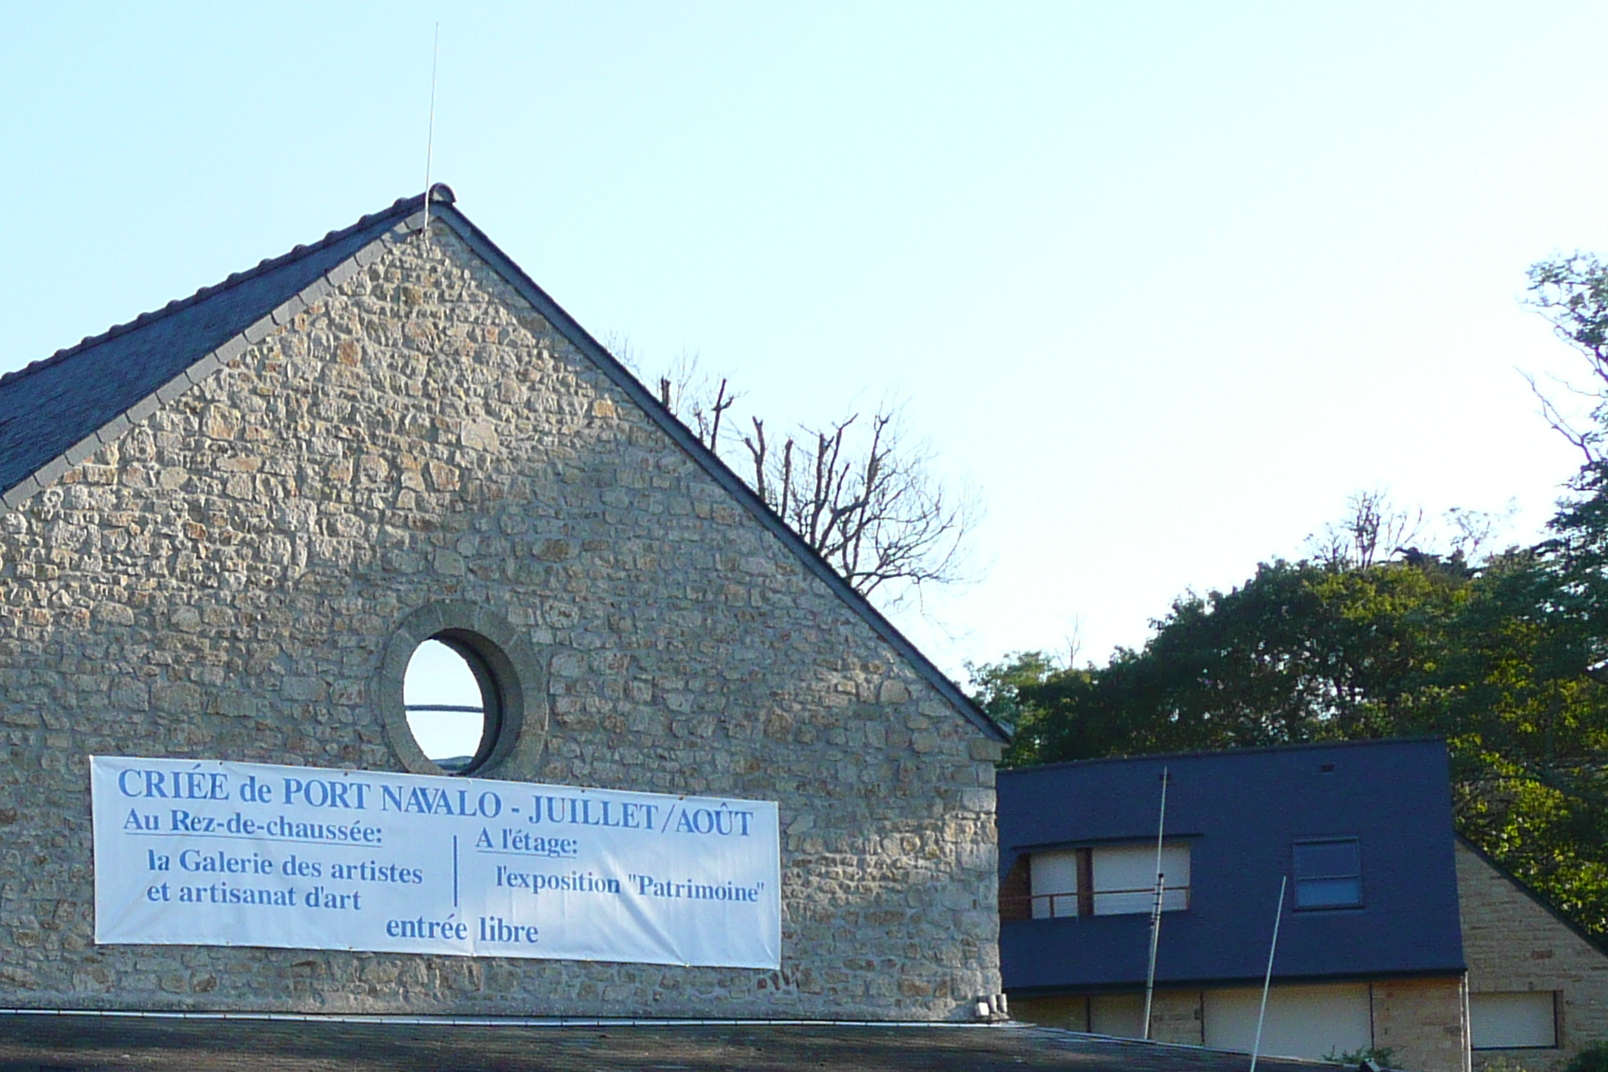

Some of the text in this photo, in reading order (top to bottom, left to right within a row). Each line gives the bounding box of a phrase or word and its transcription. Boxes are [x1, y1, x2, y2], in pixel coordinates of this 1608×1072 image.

[118, 763, 230, 801] CRIÉE
[239, 776, 272, 804] de
[282, 777, 371, 810] PORT
[380, 784, 502, 819] NAVALO
[123, 807, 383, 844] Au Rez-de-chaussée:
[475, 827, 578, 857] A l'étage:
[147, 849, 423, 884] la Galerie des artistes
[496, 866, 765, 902] l'exposition "Patrimoine"
[147, 882, 362, 911] et artisanat d'art
[386, 914, 540, 943] entrée libre
